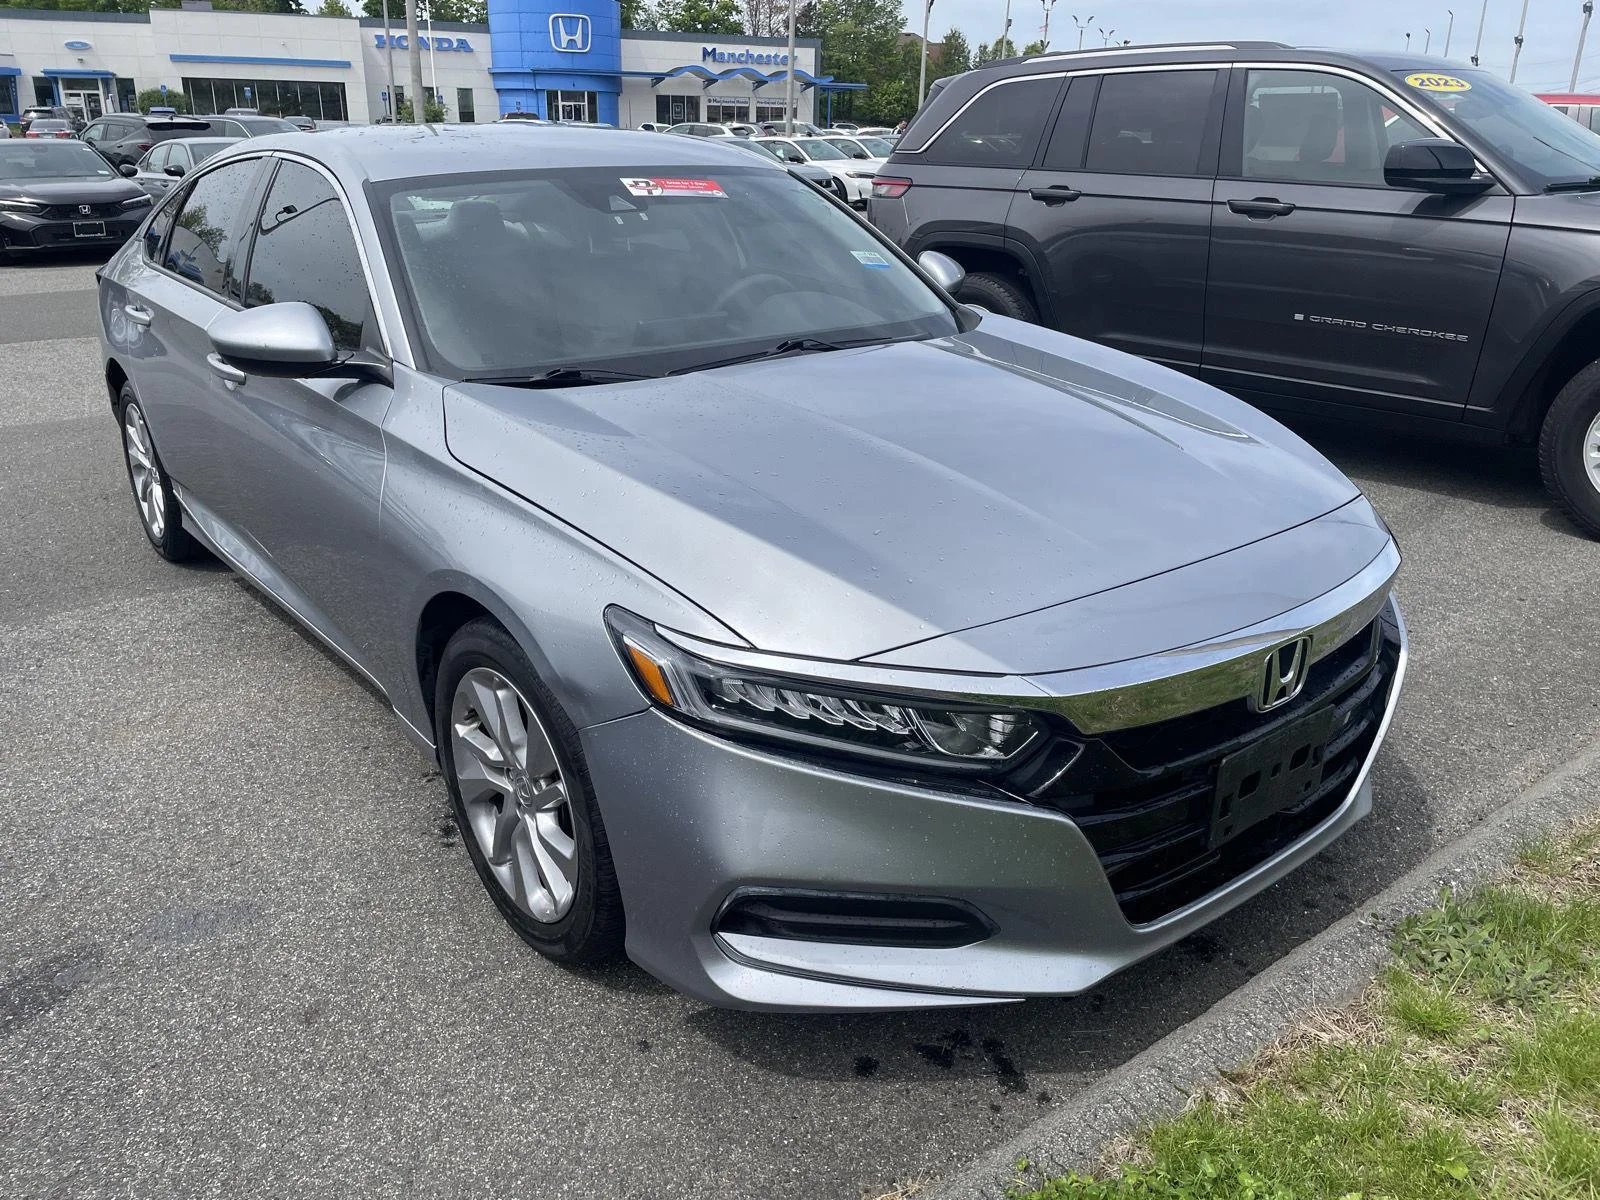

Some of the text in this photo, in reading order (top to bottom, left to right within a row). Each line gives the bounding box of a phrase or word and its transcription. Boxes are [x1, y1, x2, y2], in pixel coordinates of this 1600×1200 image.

[374, 35, 474, 52] HONDA
[1413, 77, 1466, 88] 2023
[1309, 315, 1468, 342] GRAND CHEROKEE
